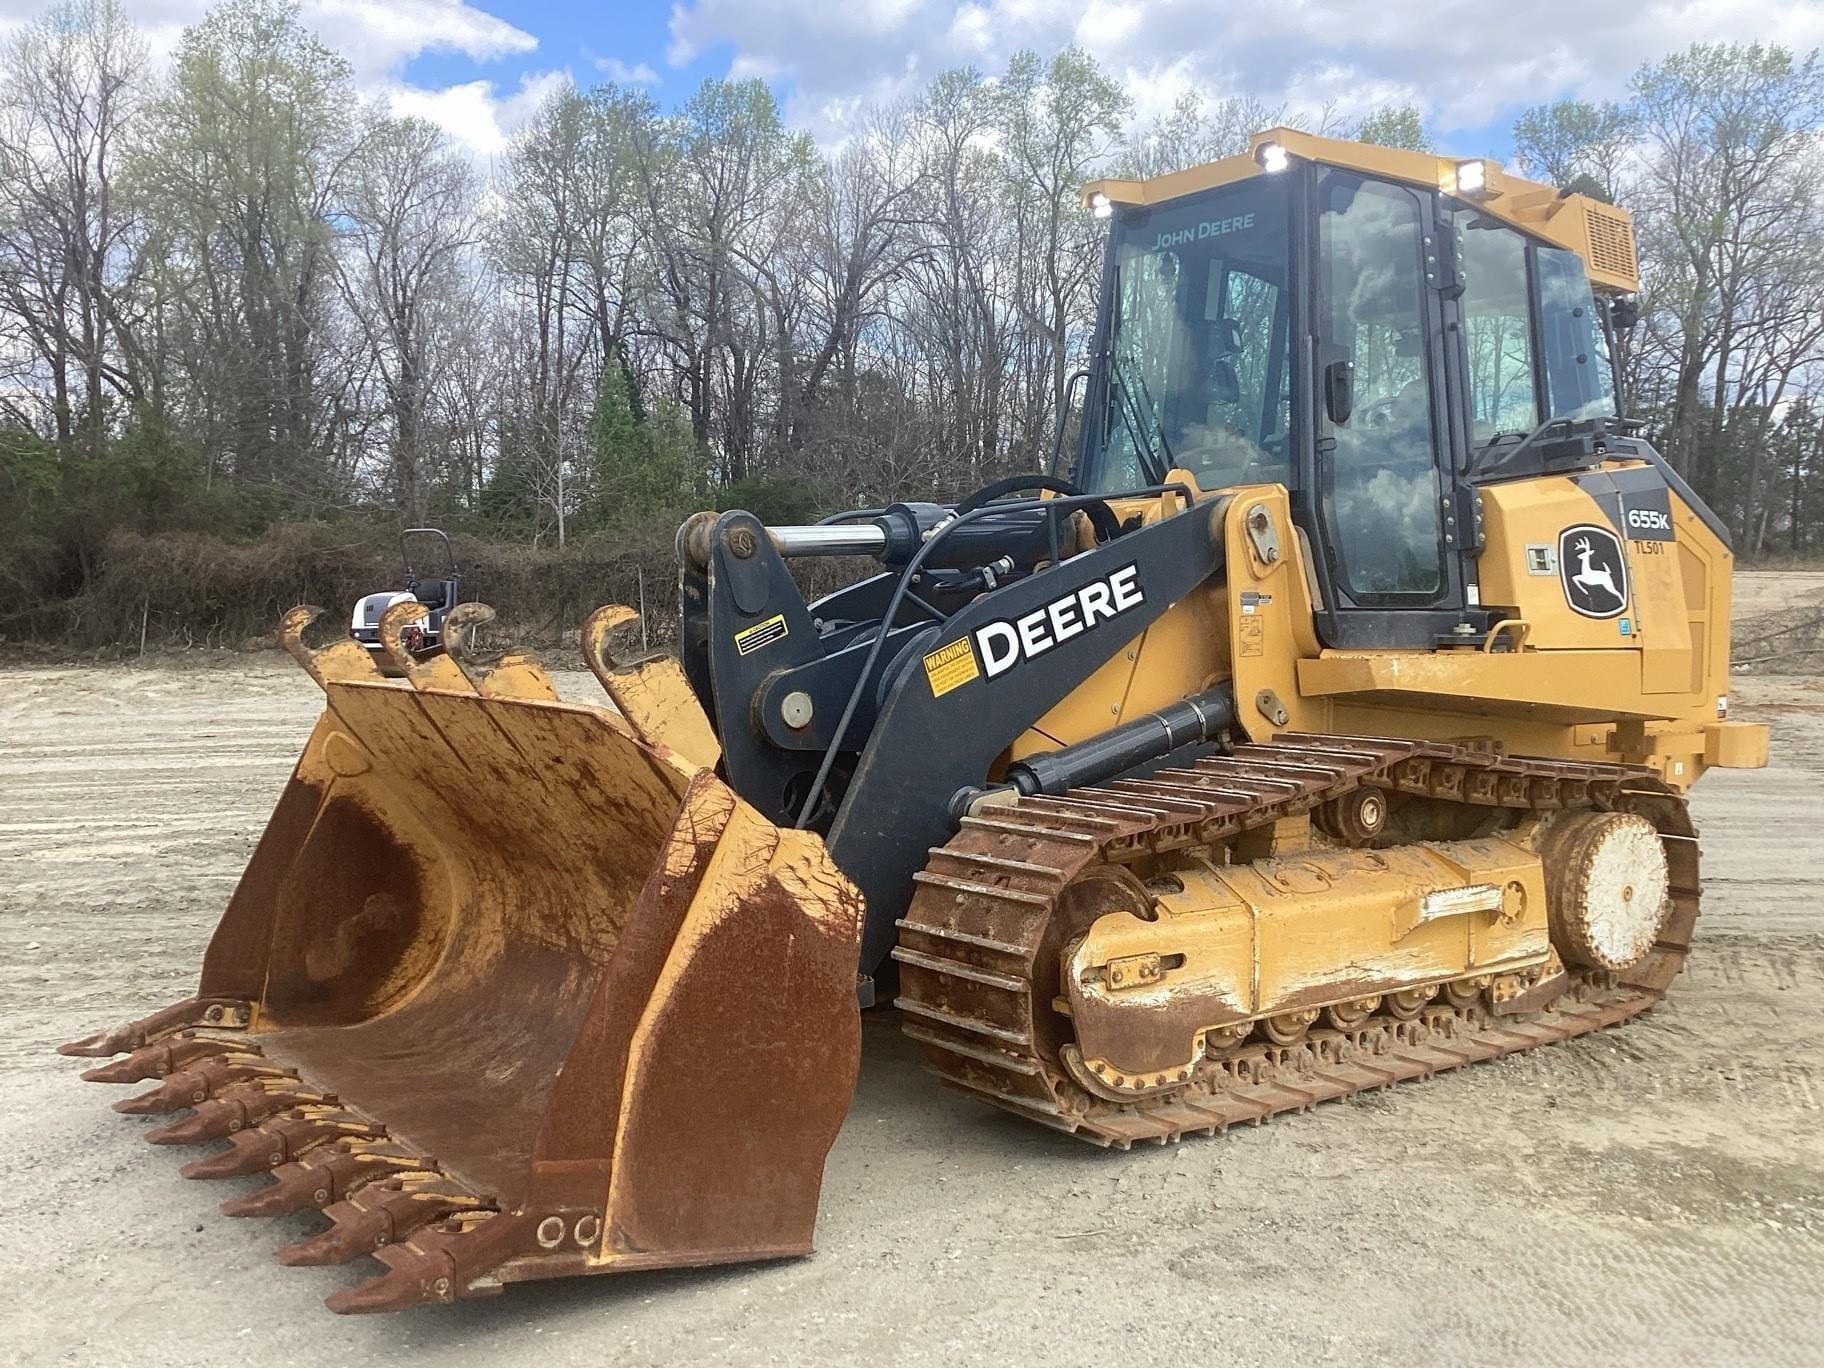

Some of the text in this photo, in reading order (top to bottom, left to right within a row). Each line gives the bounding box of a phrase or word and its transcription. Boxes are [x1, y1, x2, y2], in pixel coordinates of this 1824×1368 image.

[1152, 213, 1255, 251] JOHN DEERE
[1628, 509, 1671, 530] 655K
[1634, 541, 1664, 555] TL501
[976, 565, 1144, 678] DEERE
[925, 640, 970, 671] WARNING
